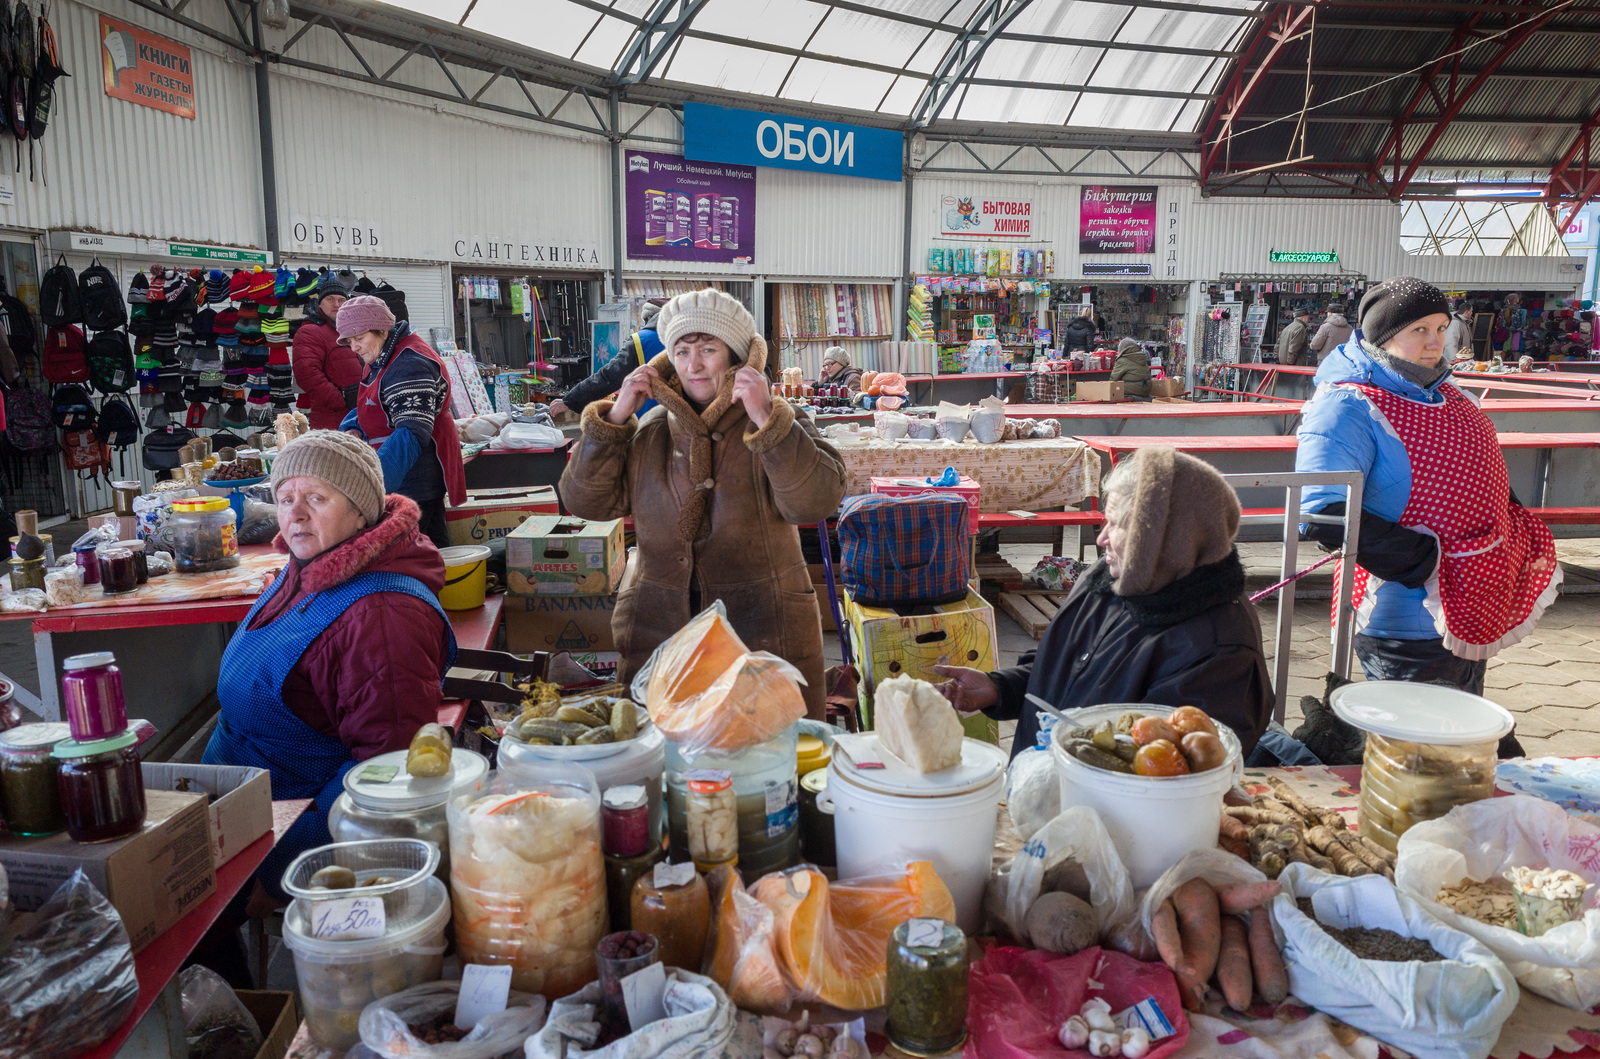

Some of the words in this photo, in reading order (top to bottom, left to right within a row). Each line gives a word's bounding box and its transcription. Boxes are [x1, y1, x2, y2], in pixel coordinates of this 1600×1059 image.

[138, 43, 190, 75] КНИГИ
[149, 71, 191, 94] ГАЗЕТЫ
[134, 81, 192, 110] ЖУРНАЛЫ
[756, 119, 854, 168] ОБОИ
[630, 159, 649, 169] Metylan
[653, 160, 684, 172] Лучший.
[685, 164, 724, 176] Немецкий.
[676, 177, 699, 185] Обойный
[1085, 189, 1153, 205] Бижутерия
[983, 201, 1030, 216] БЫТОВАЯ
[1103, 205, 1132, 215] заколки
[994, 219, 1030, 233] ХИМИЯ
[1088, 217, 1118, 227] резинки
[1123, 217, 1149, 227] обручи
[294, 222, 379, 246] ОБУВЬ
[1085, 228, 1115, 238] сережки
[1121, 229, 1149, 238] брошки
[1167, 202, 1178, 277] ПРЯДИ
[206, 248, 209, 256] 2
[454, 239, 599, 264] САНТЕХНИКА
[1099, 240, 1135, 250] браслеты
[1279, 253, 1331, 261] АКСЕССУАРОВ
[87, 276, 103, 287] NIKE
[532, 563, 579, 572] ARTES
[525, 596, 616, 612] BANANAS
